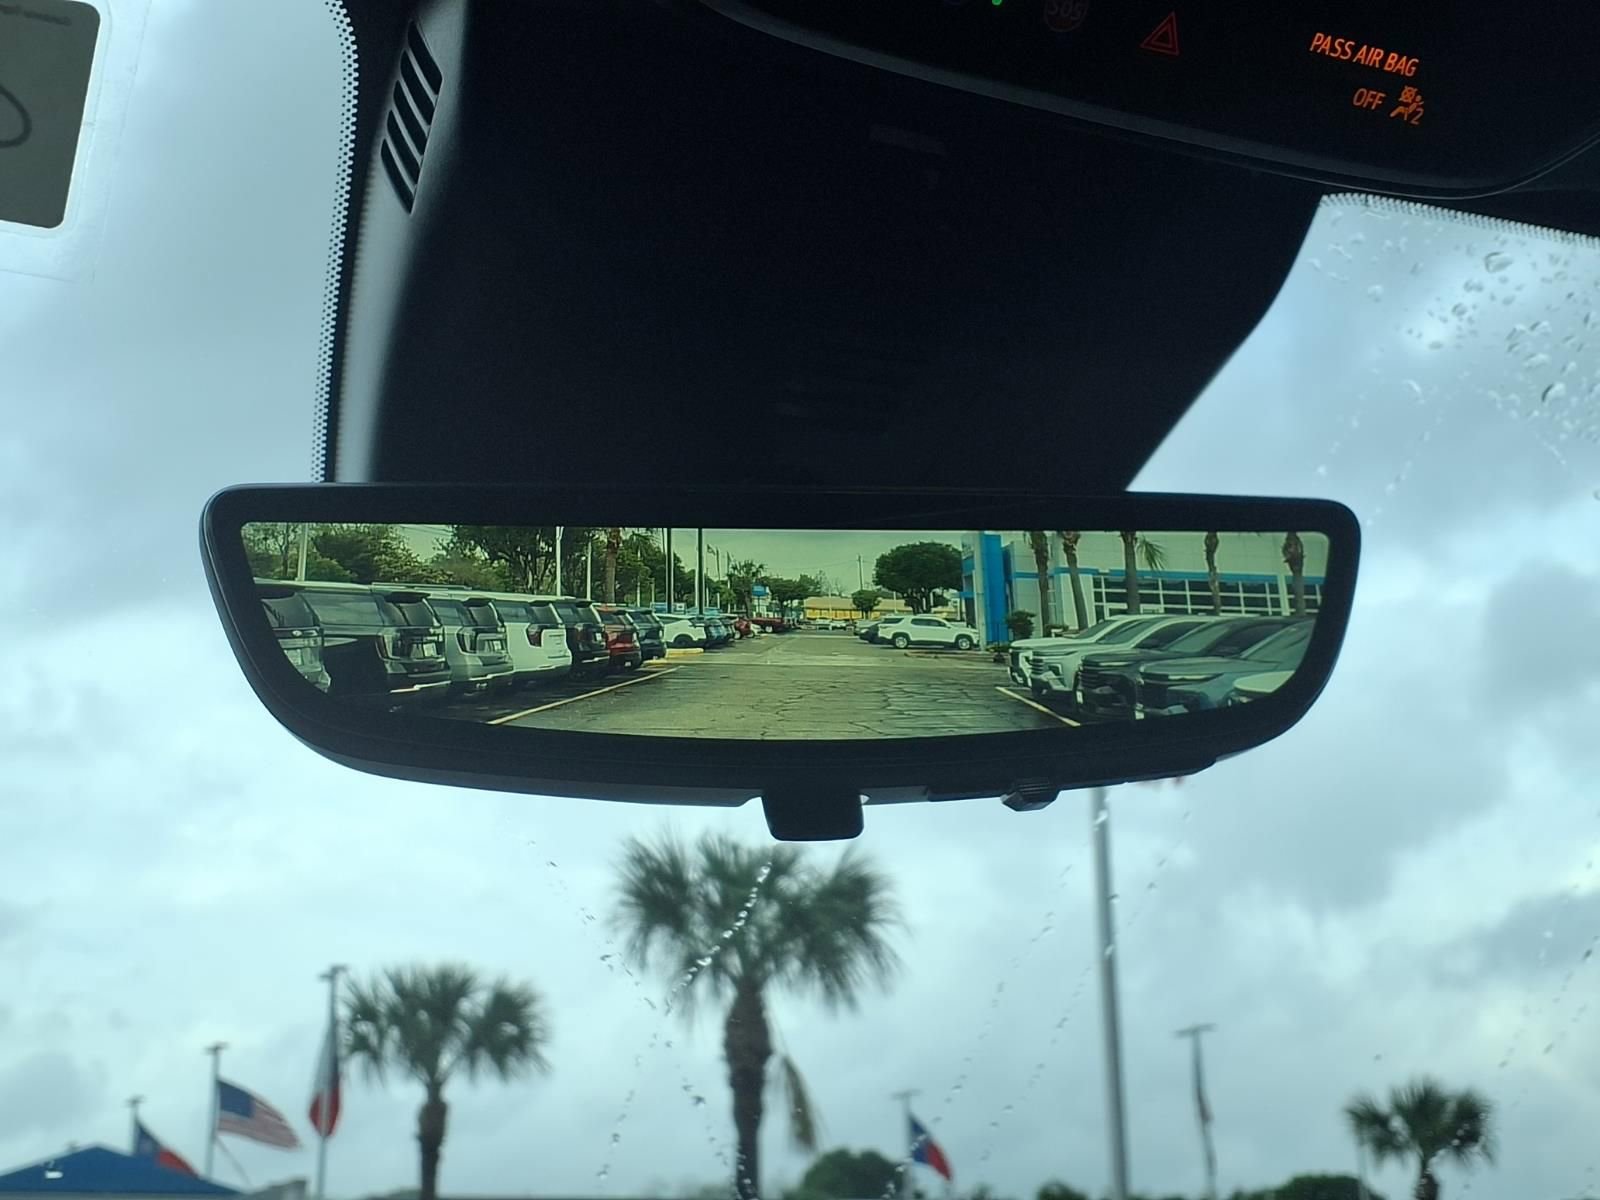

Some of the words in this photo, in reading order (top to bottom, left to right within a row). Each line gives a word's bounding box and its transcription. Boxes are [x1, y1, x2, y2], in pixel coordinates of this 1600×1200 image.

[1310, 32, 1355, 60] PASS
[1352, 44, 1385, 68] AIR
[1384, 52, 1420, 77] BAG
[1352, 87, 1387, 110] OFF
